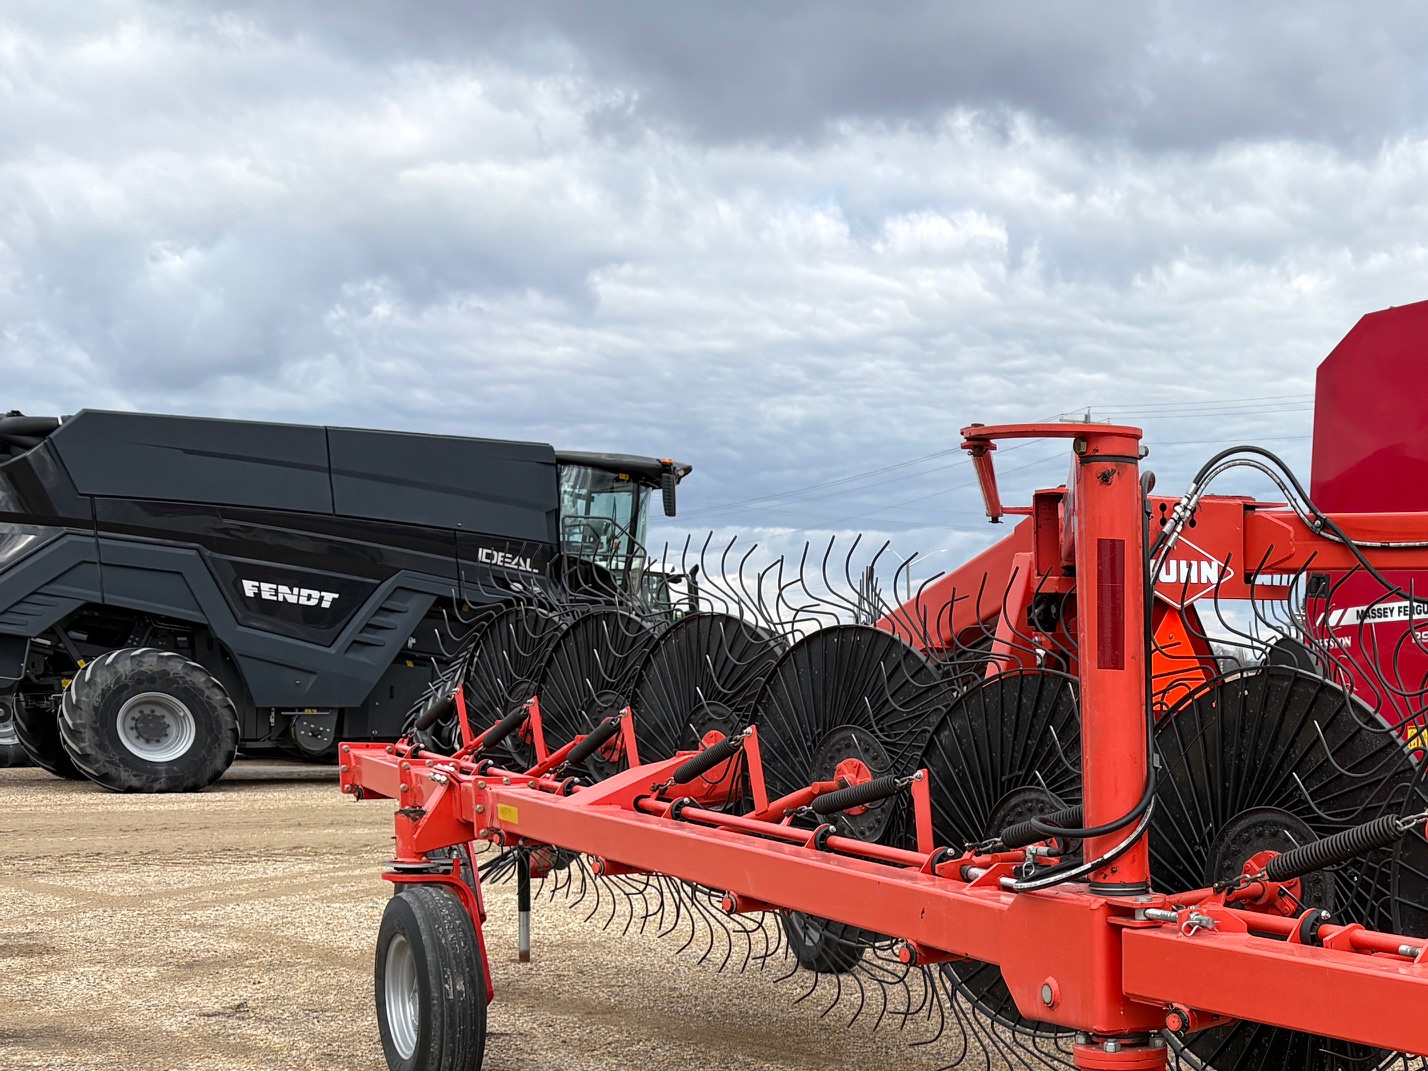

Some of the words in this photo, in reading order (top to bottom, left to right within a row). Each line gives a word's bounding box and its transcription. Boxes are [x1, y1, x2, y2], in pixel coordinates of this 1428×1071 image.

[478, 547, 539, 573] IDEAL
[241, 579, 340, 609] FENDT
[1356, 606, 1395, 620] MASSEY
